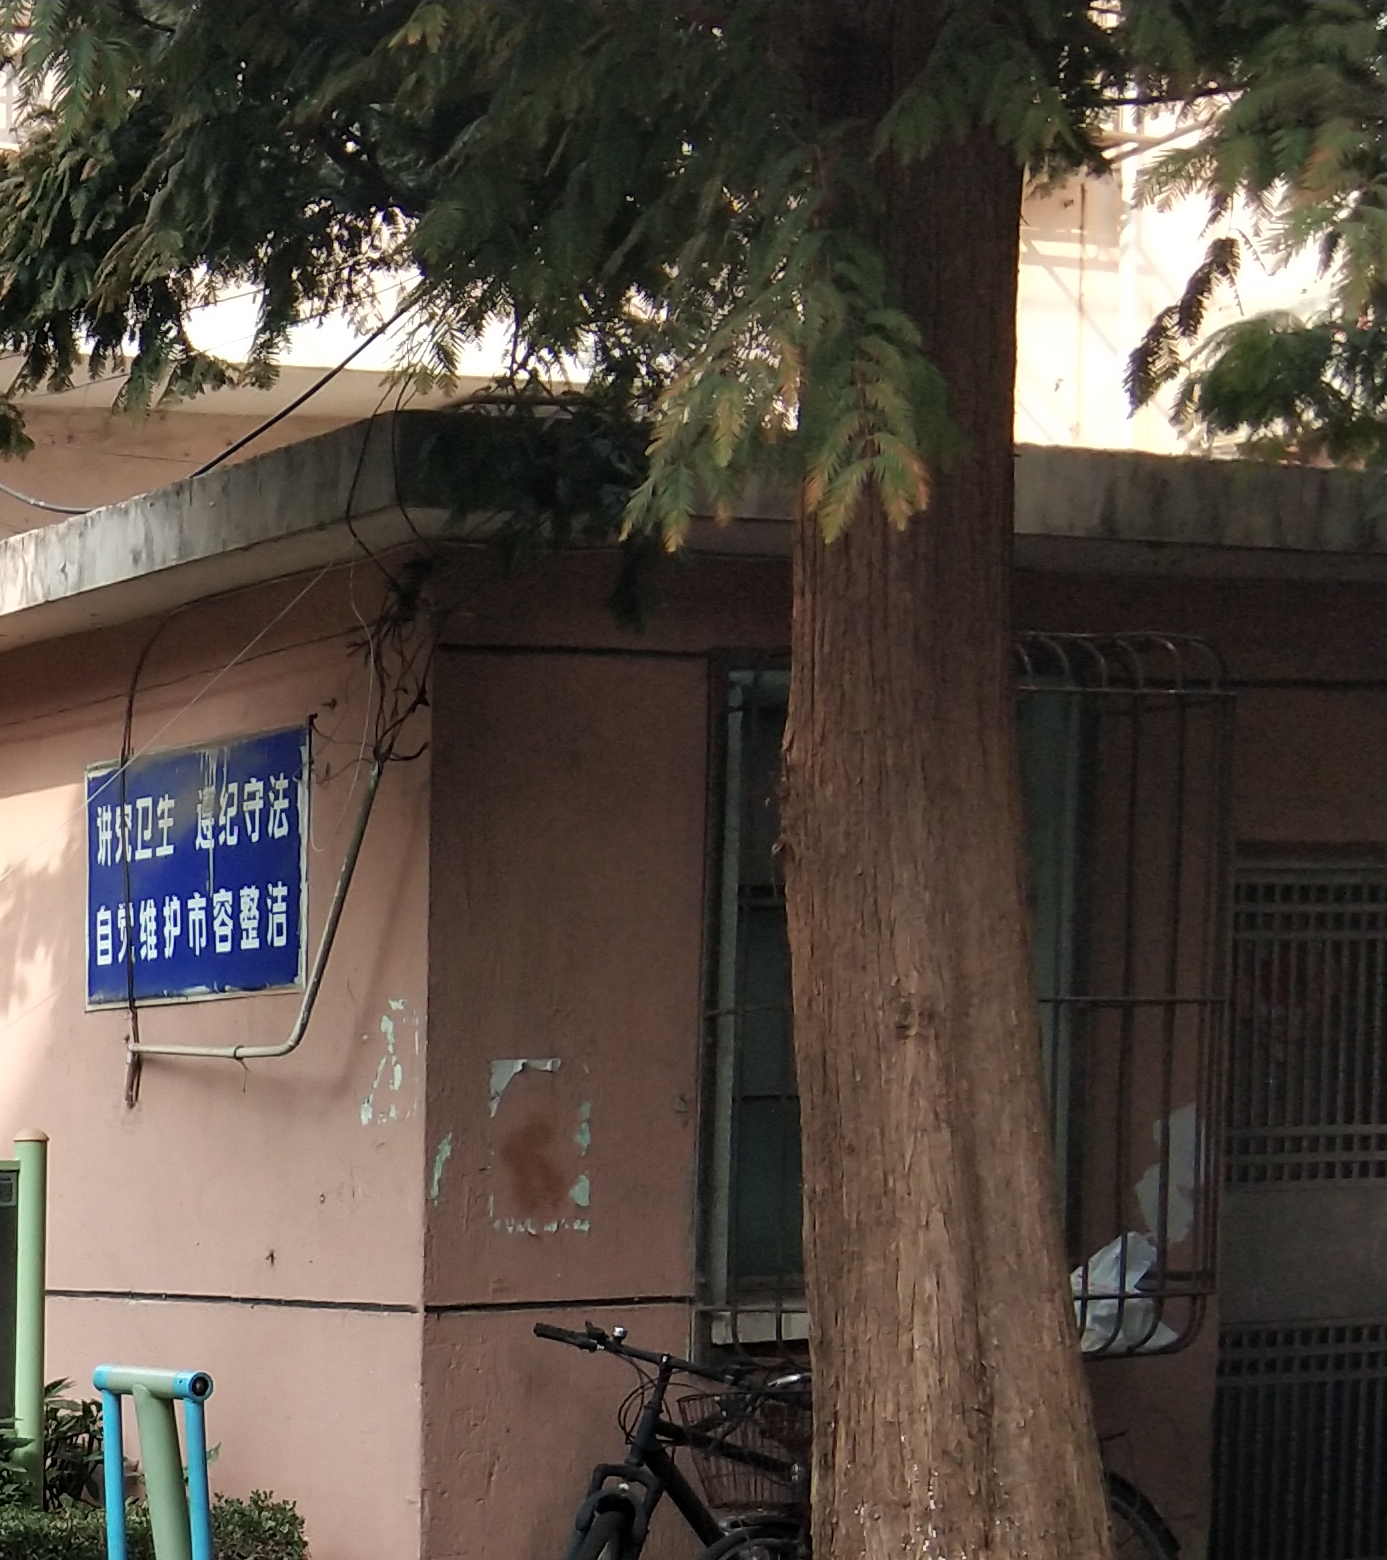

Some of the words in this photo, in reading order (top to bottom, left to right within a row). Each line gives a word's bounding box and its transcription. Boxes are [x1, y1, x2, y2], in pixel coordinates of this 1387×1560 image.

[96, 794, 176, 866] 讲究卫生
[96, 880, 289, 966] 自觉维护市容整洁
